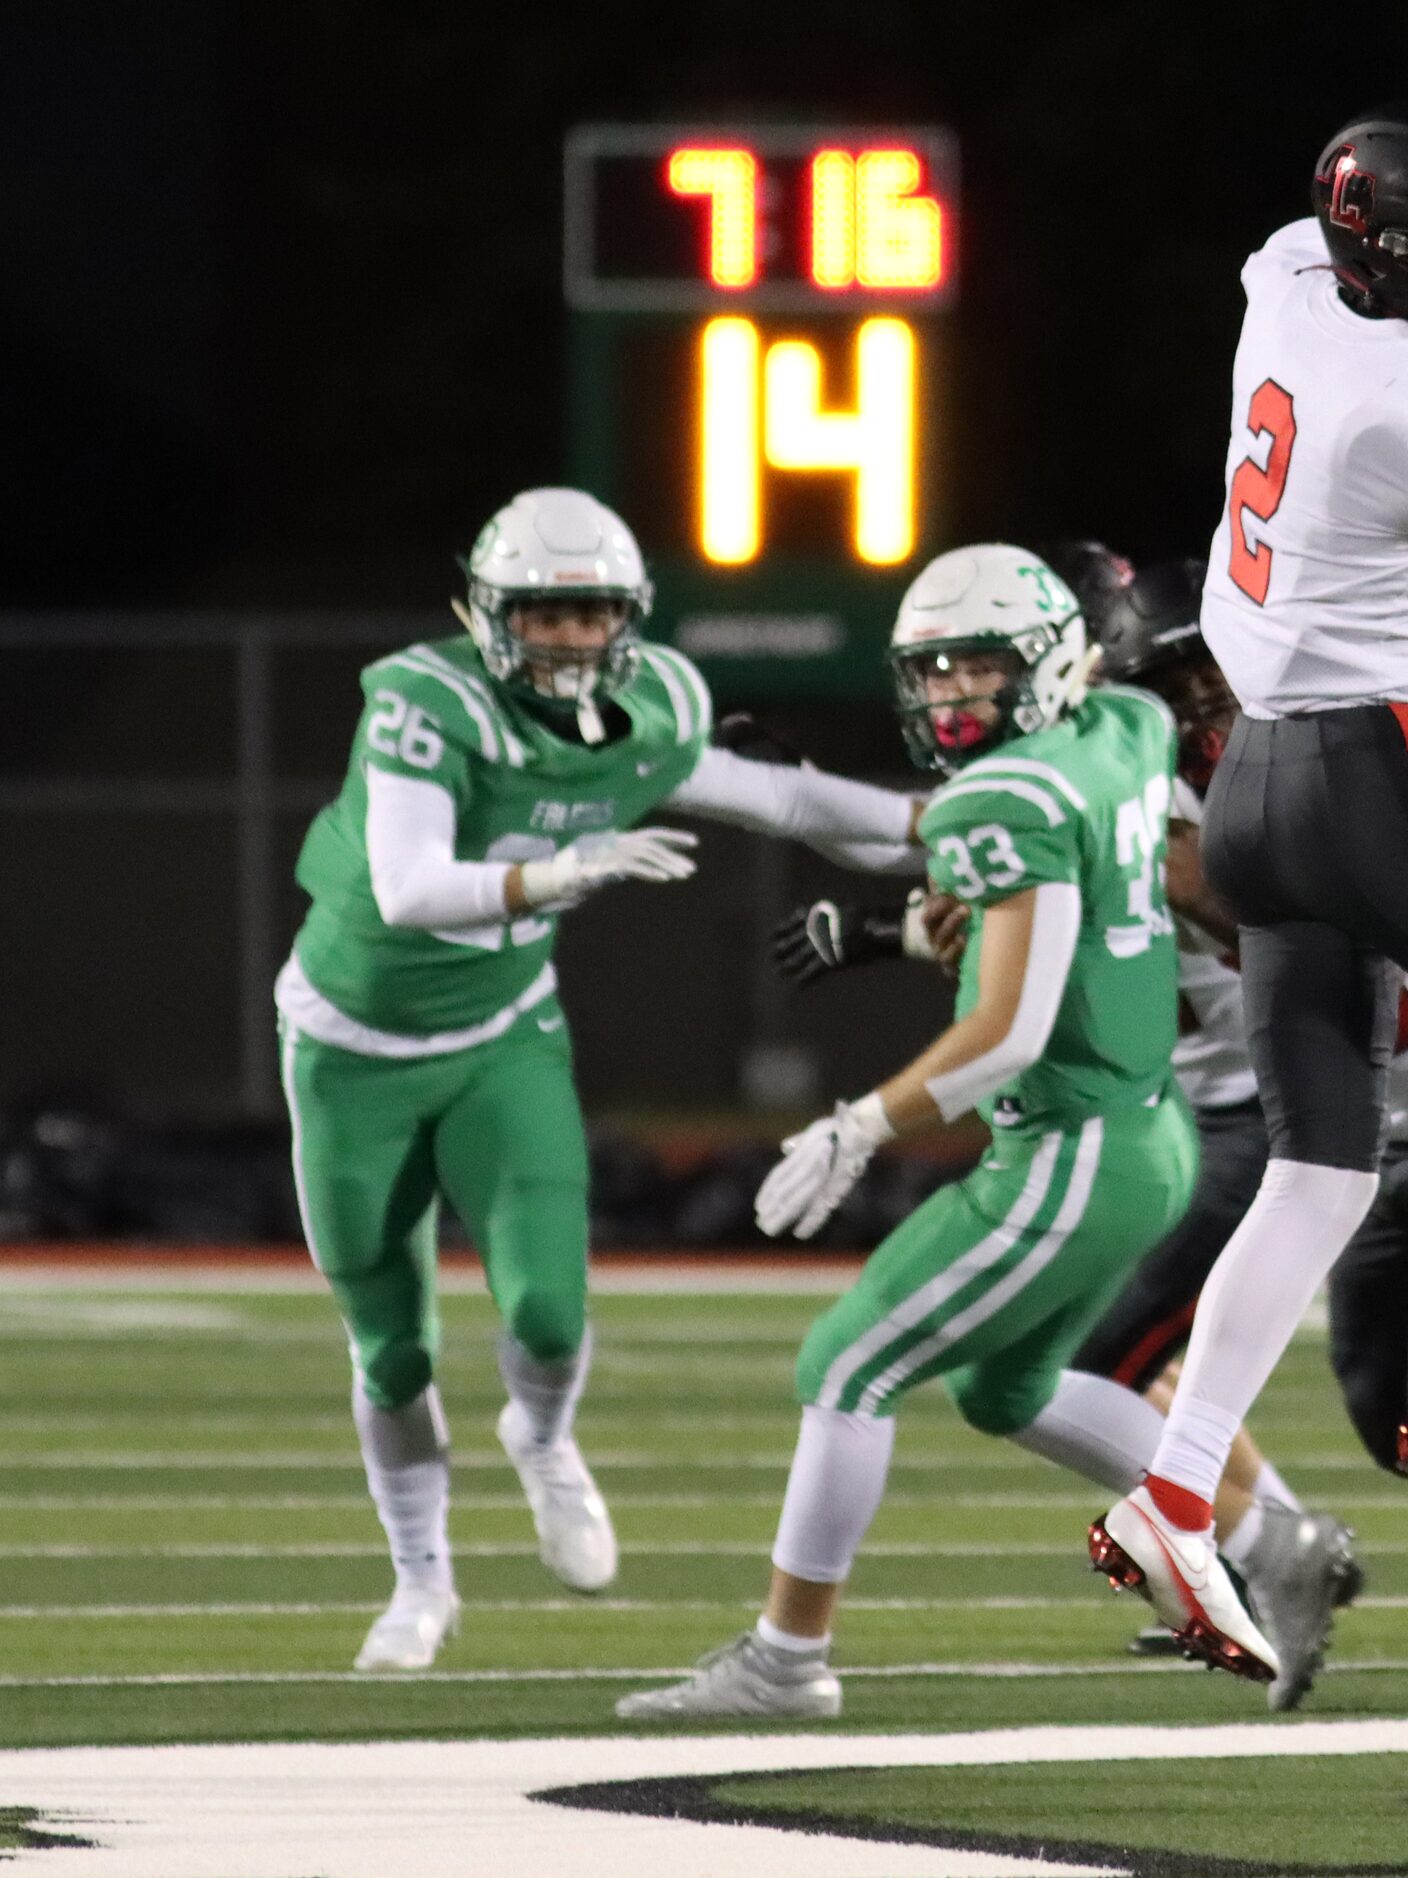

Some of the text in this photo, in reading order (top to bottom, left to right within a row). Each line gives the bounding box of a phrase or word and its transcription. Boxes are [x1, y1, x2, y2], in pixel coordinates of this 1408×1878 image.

[701, 316, 915, 565] 14
[1227, 377, 1297, 607] 2
[366, 688, 445, 769] 26
[937, 823, 1026, 899] 33
